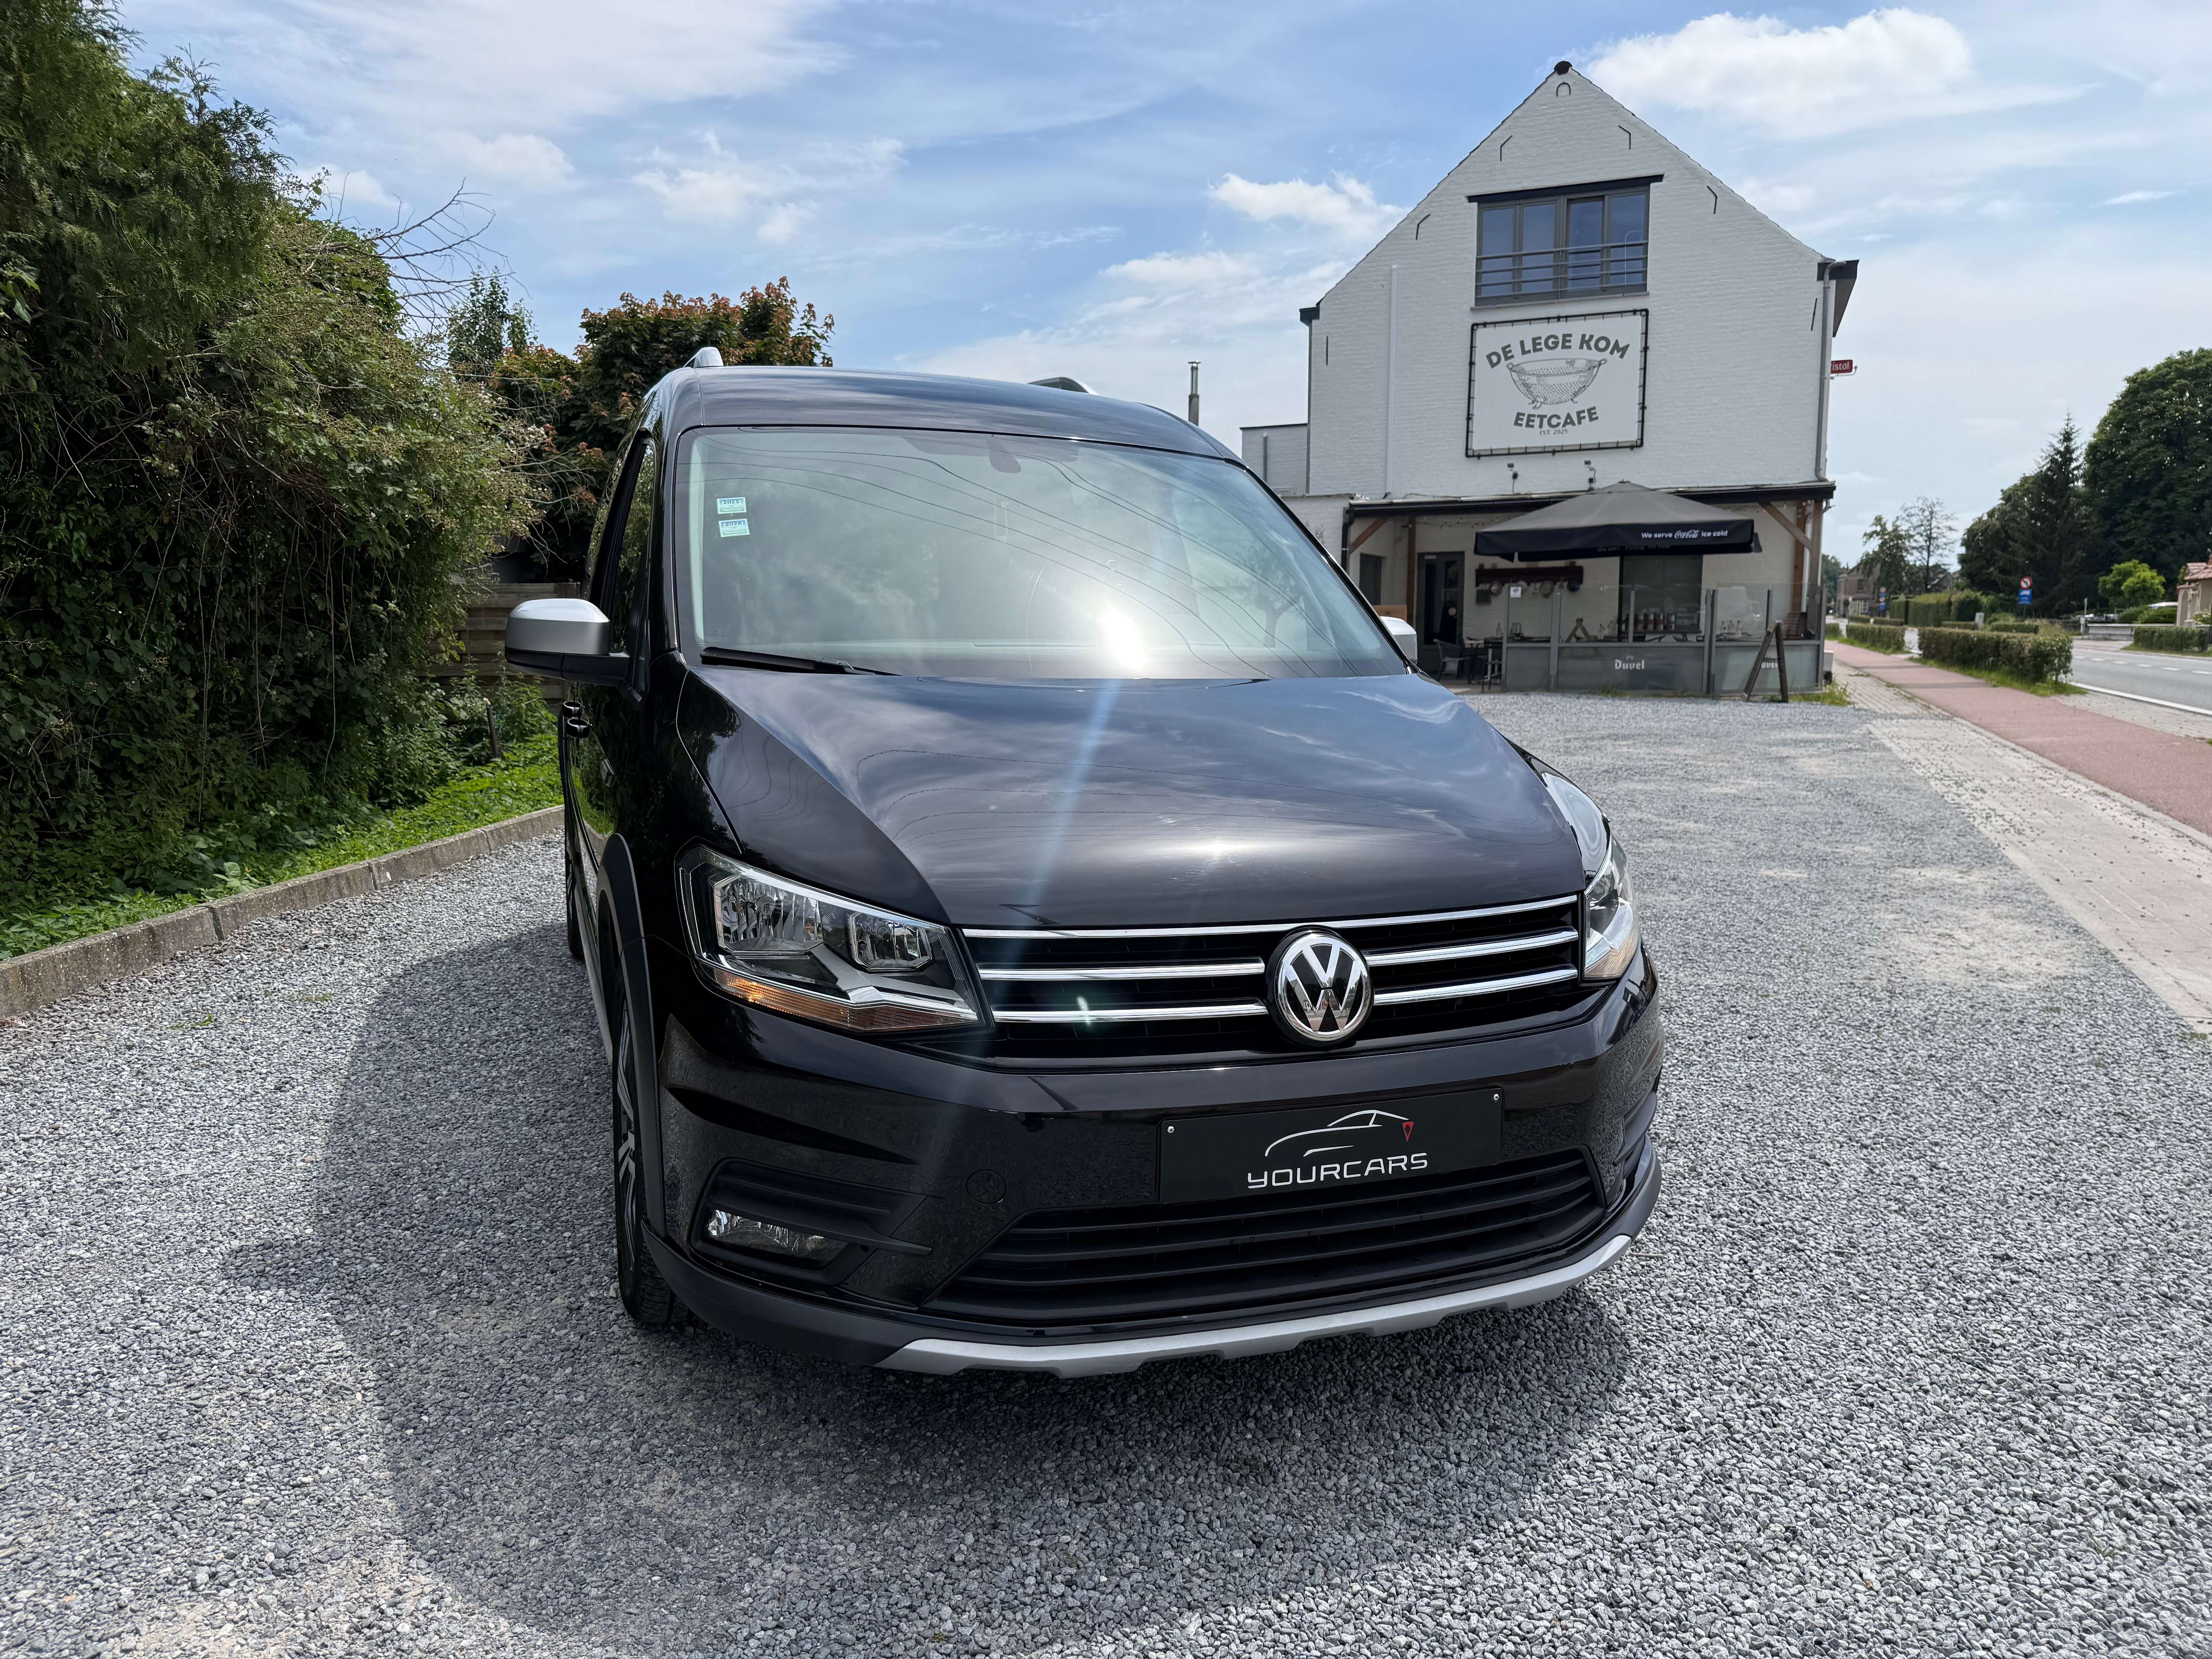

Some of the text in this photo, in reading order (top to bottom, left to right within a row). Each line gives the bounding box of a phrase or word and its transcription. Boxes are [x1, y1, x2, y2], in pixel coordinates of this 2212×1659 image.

[1486, 333, 1630, 369] DE LEGE KOM
[1832, 361, 1850, 371] istal
[1513, 406, 1599, 429] EETCAFE
[1614, 659, 1645, 670] Duvel
[1247, 1152, 1428, 1189] YOURCARS
